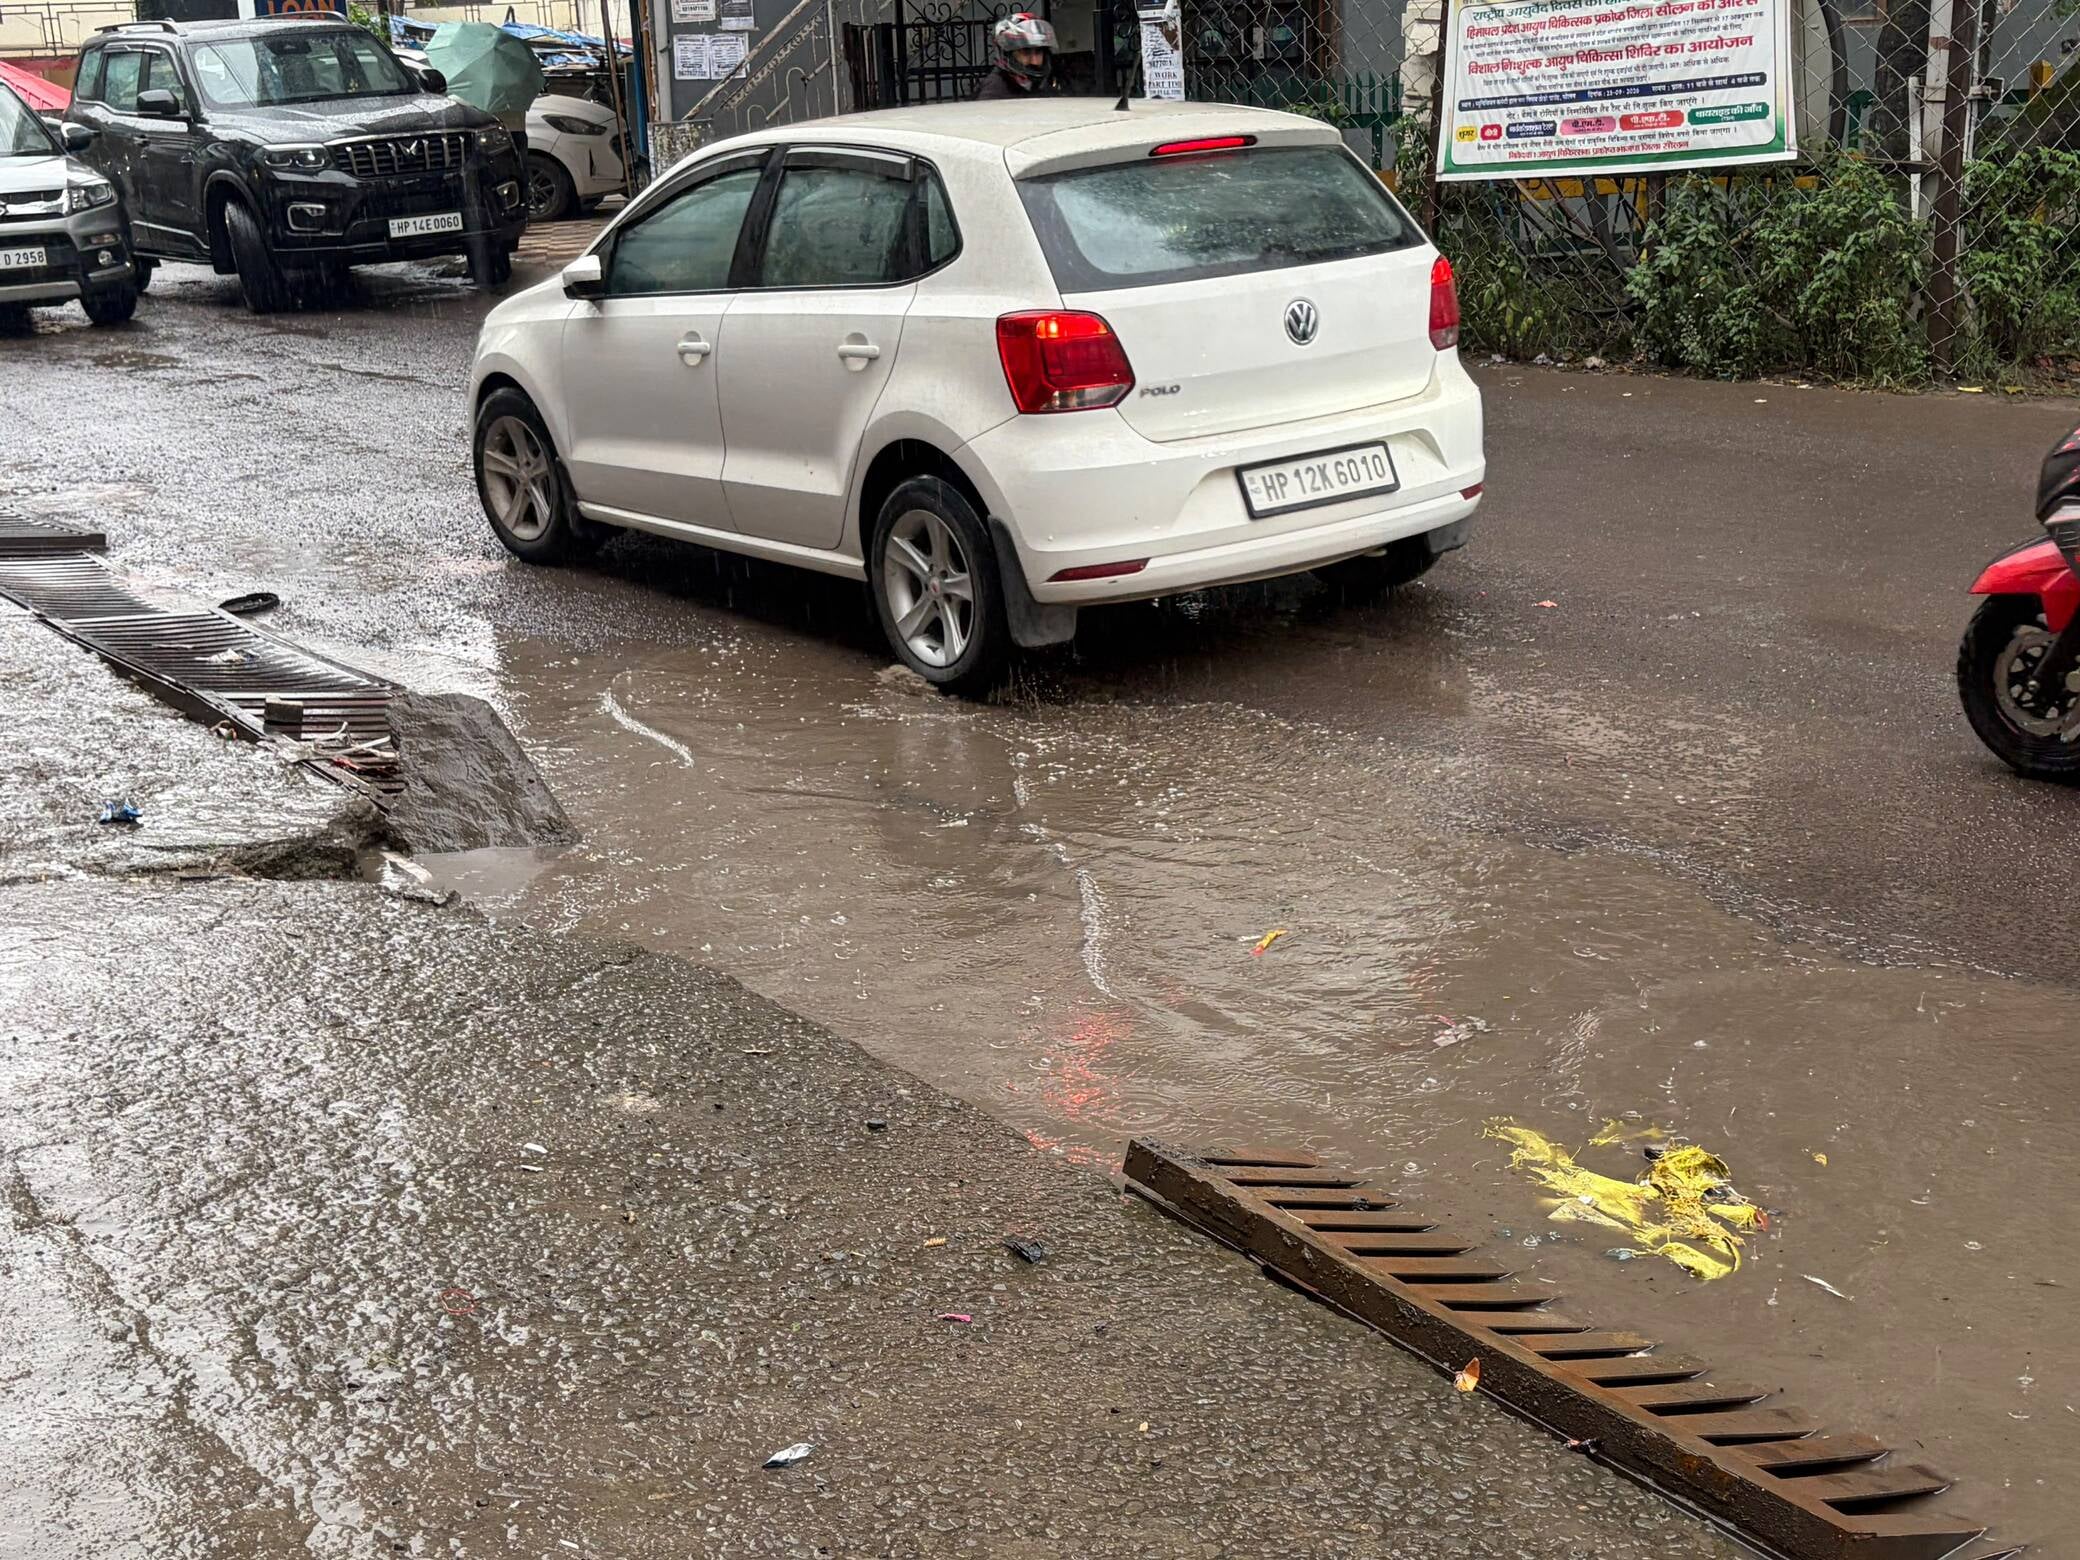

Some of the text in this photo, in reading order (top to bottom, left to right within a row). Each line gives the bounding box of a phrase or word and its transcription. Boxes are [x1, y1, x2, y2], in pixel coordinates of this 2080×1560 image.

[1473, 8, 1503, 22] राष्ट्रीय
[1507, 1, 1547, 19] आयुर्वेद
[1548, 14, 1592, 29] चिकित्सक
[1594, 8, 1624, 25] प्रकोष्ठ
[1655, 0, 1693, 16] सोलन
[1468, 58, 1499, 74] विशाल
[1576, 48, 1622, 63] चिकित्सा
[1625, 41, 1660, 58] शिविर
[1664, 42, 1684, 54] का
[1688, 35, 1753, 52] आयोजन
[15, 251, 45, 265] 2958
[1139, 384, 1181, 398] POLO
